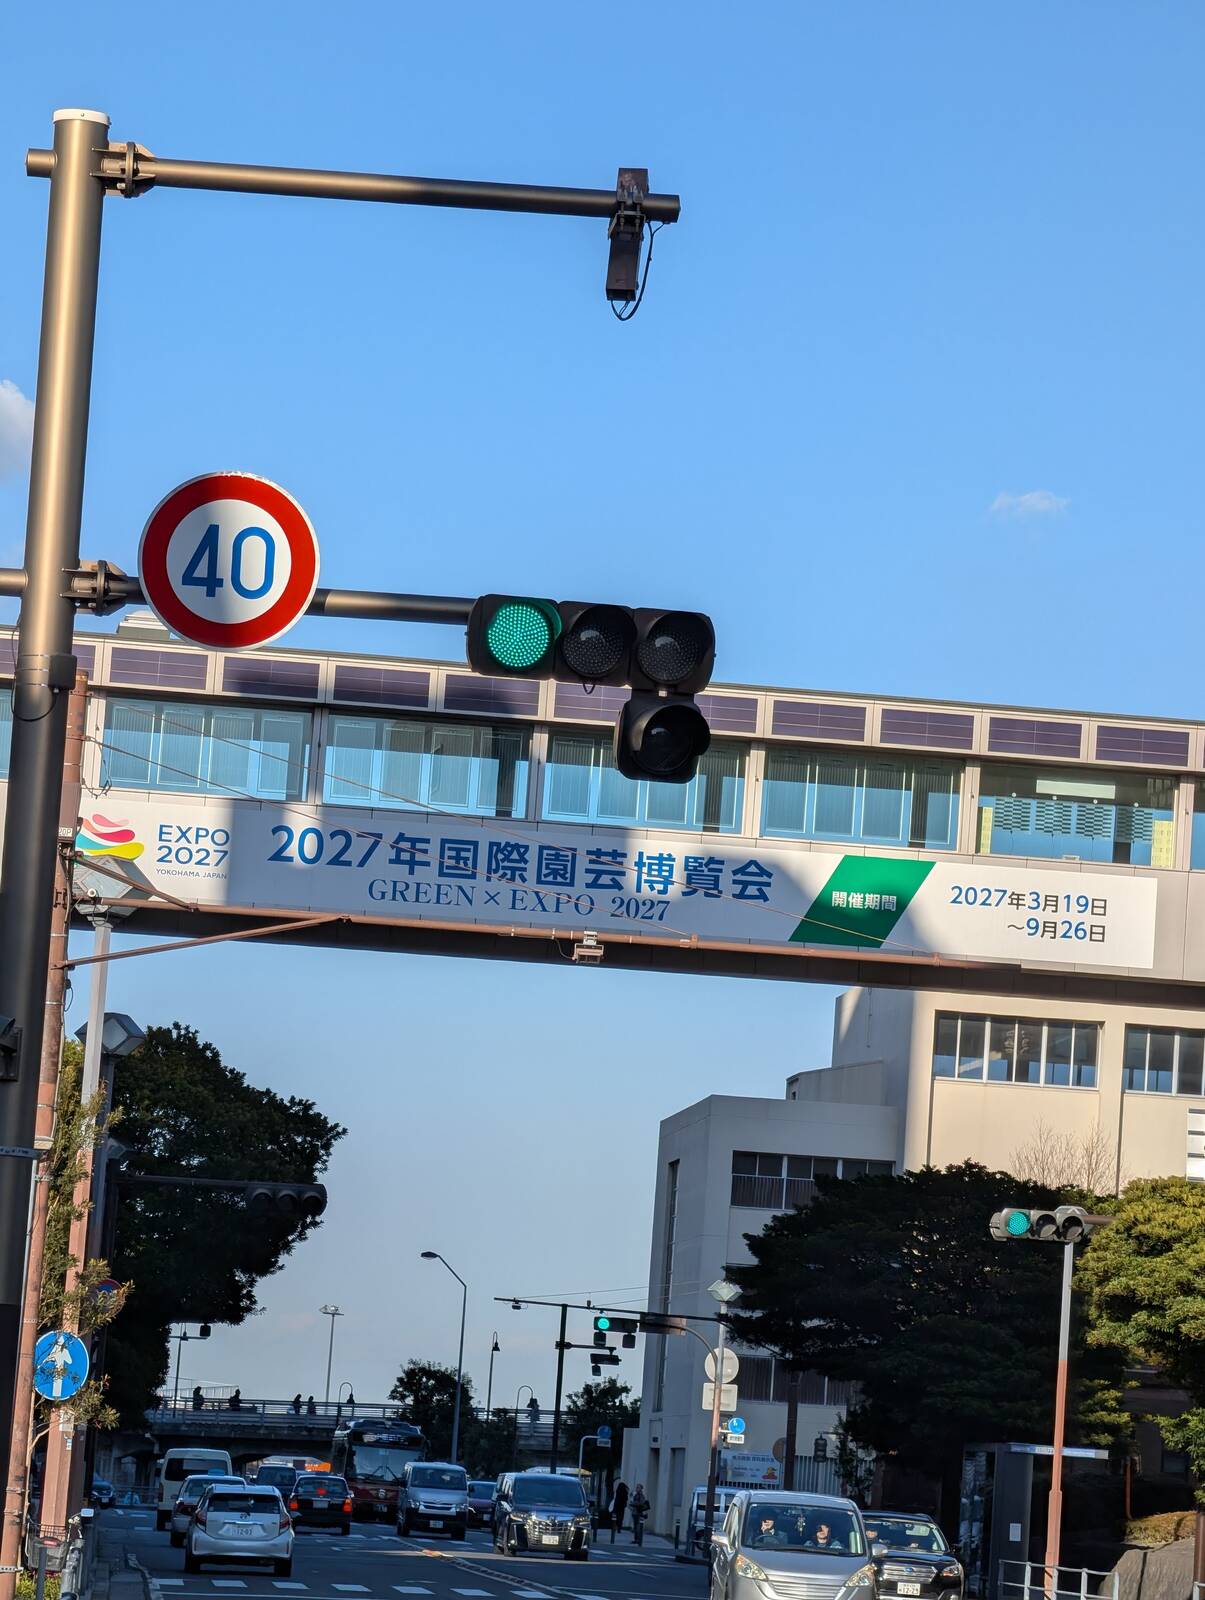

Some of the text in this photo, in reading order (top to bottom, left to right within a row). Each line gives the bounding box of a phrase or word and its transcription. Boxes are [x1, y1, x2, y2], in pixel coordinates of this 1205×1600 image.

[181, 524, 276, 600] 40
[158, 824, 230, 847] EXPO
[156, 845, 229, 867] 2027
[267, 824, 774, 903] 2027年国際園芸博覧会
[156, 868, 228, 880] YOKOHAMA JAPAN
[368, 878, 477, 907] GREEN
[508, 888, 596, 916] EXPO
[610, 895, 671, 921] 2027
[831, 890, 897, 912] 開催期間
[949, 884, 1108, 917] 2027年3月19日
